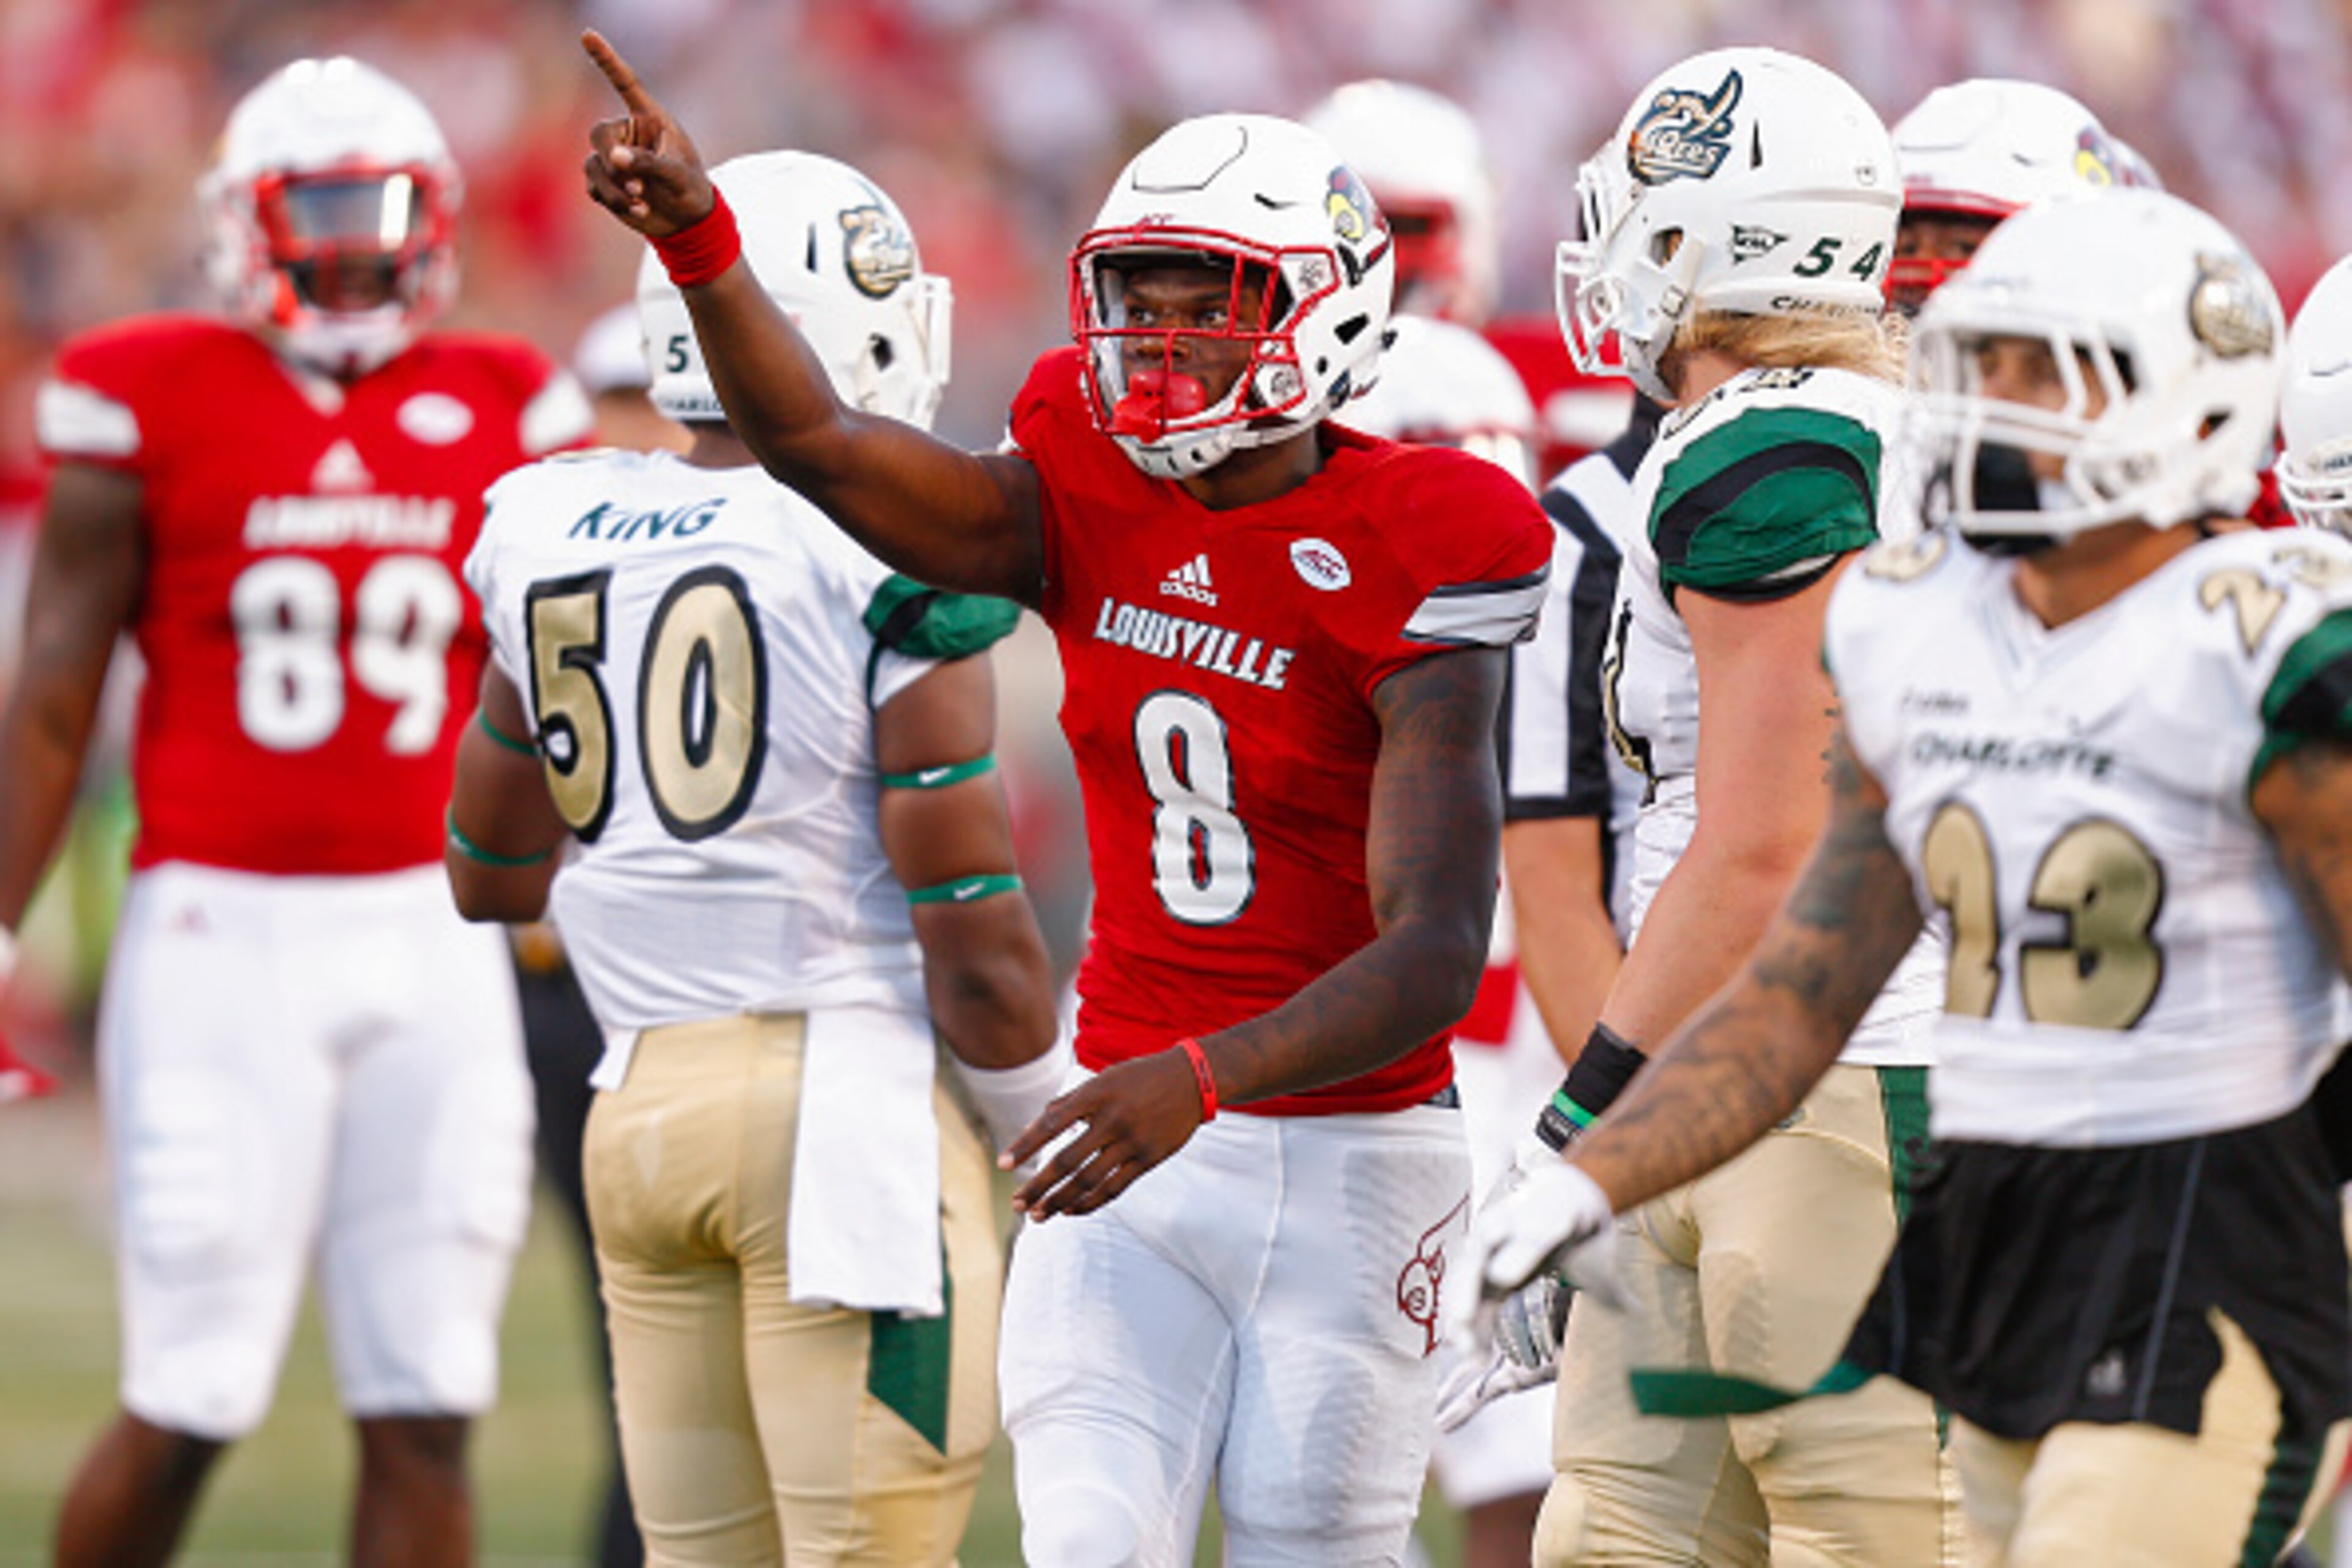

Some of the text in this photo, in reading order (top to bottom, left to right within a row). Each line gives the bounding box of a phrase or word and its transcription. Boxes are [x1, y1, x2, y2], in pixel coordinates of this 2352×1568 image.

[1792, 236, 1882, 282] 54
[566, 497, 727, 540] KING
[1159, 581, 1219, 607] adidas
[230, 553, 463, 756] 89
[1093, 597, 1295, 691] LOUISVILLE
[524, 564, 769, 845] 50
[1133, 688, 1256, 926] 8
